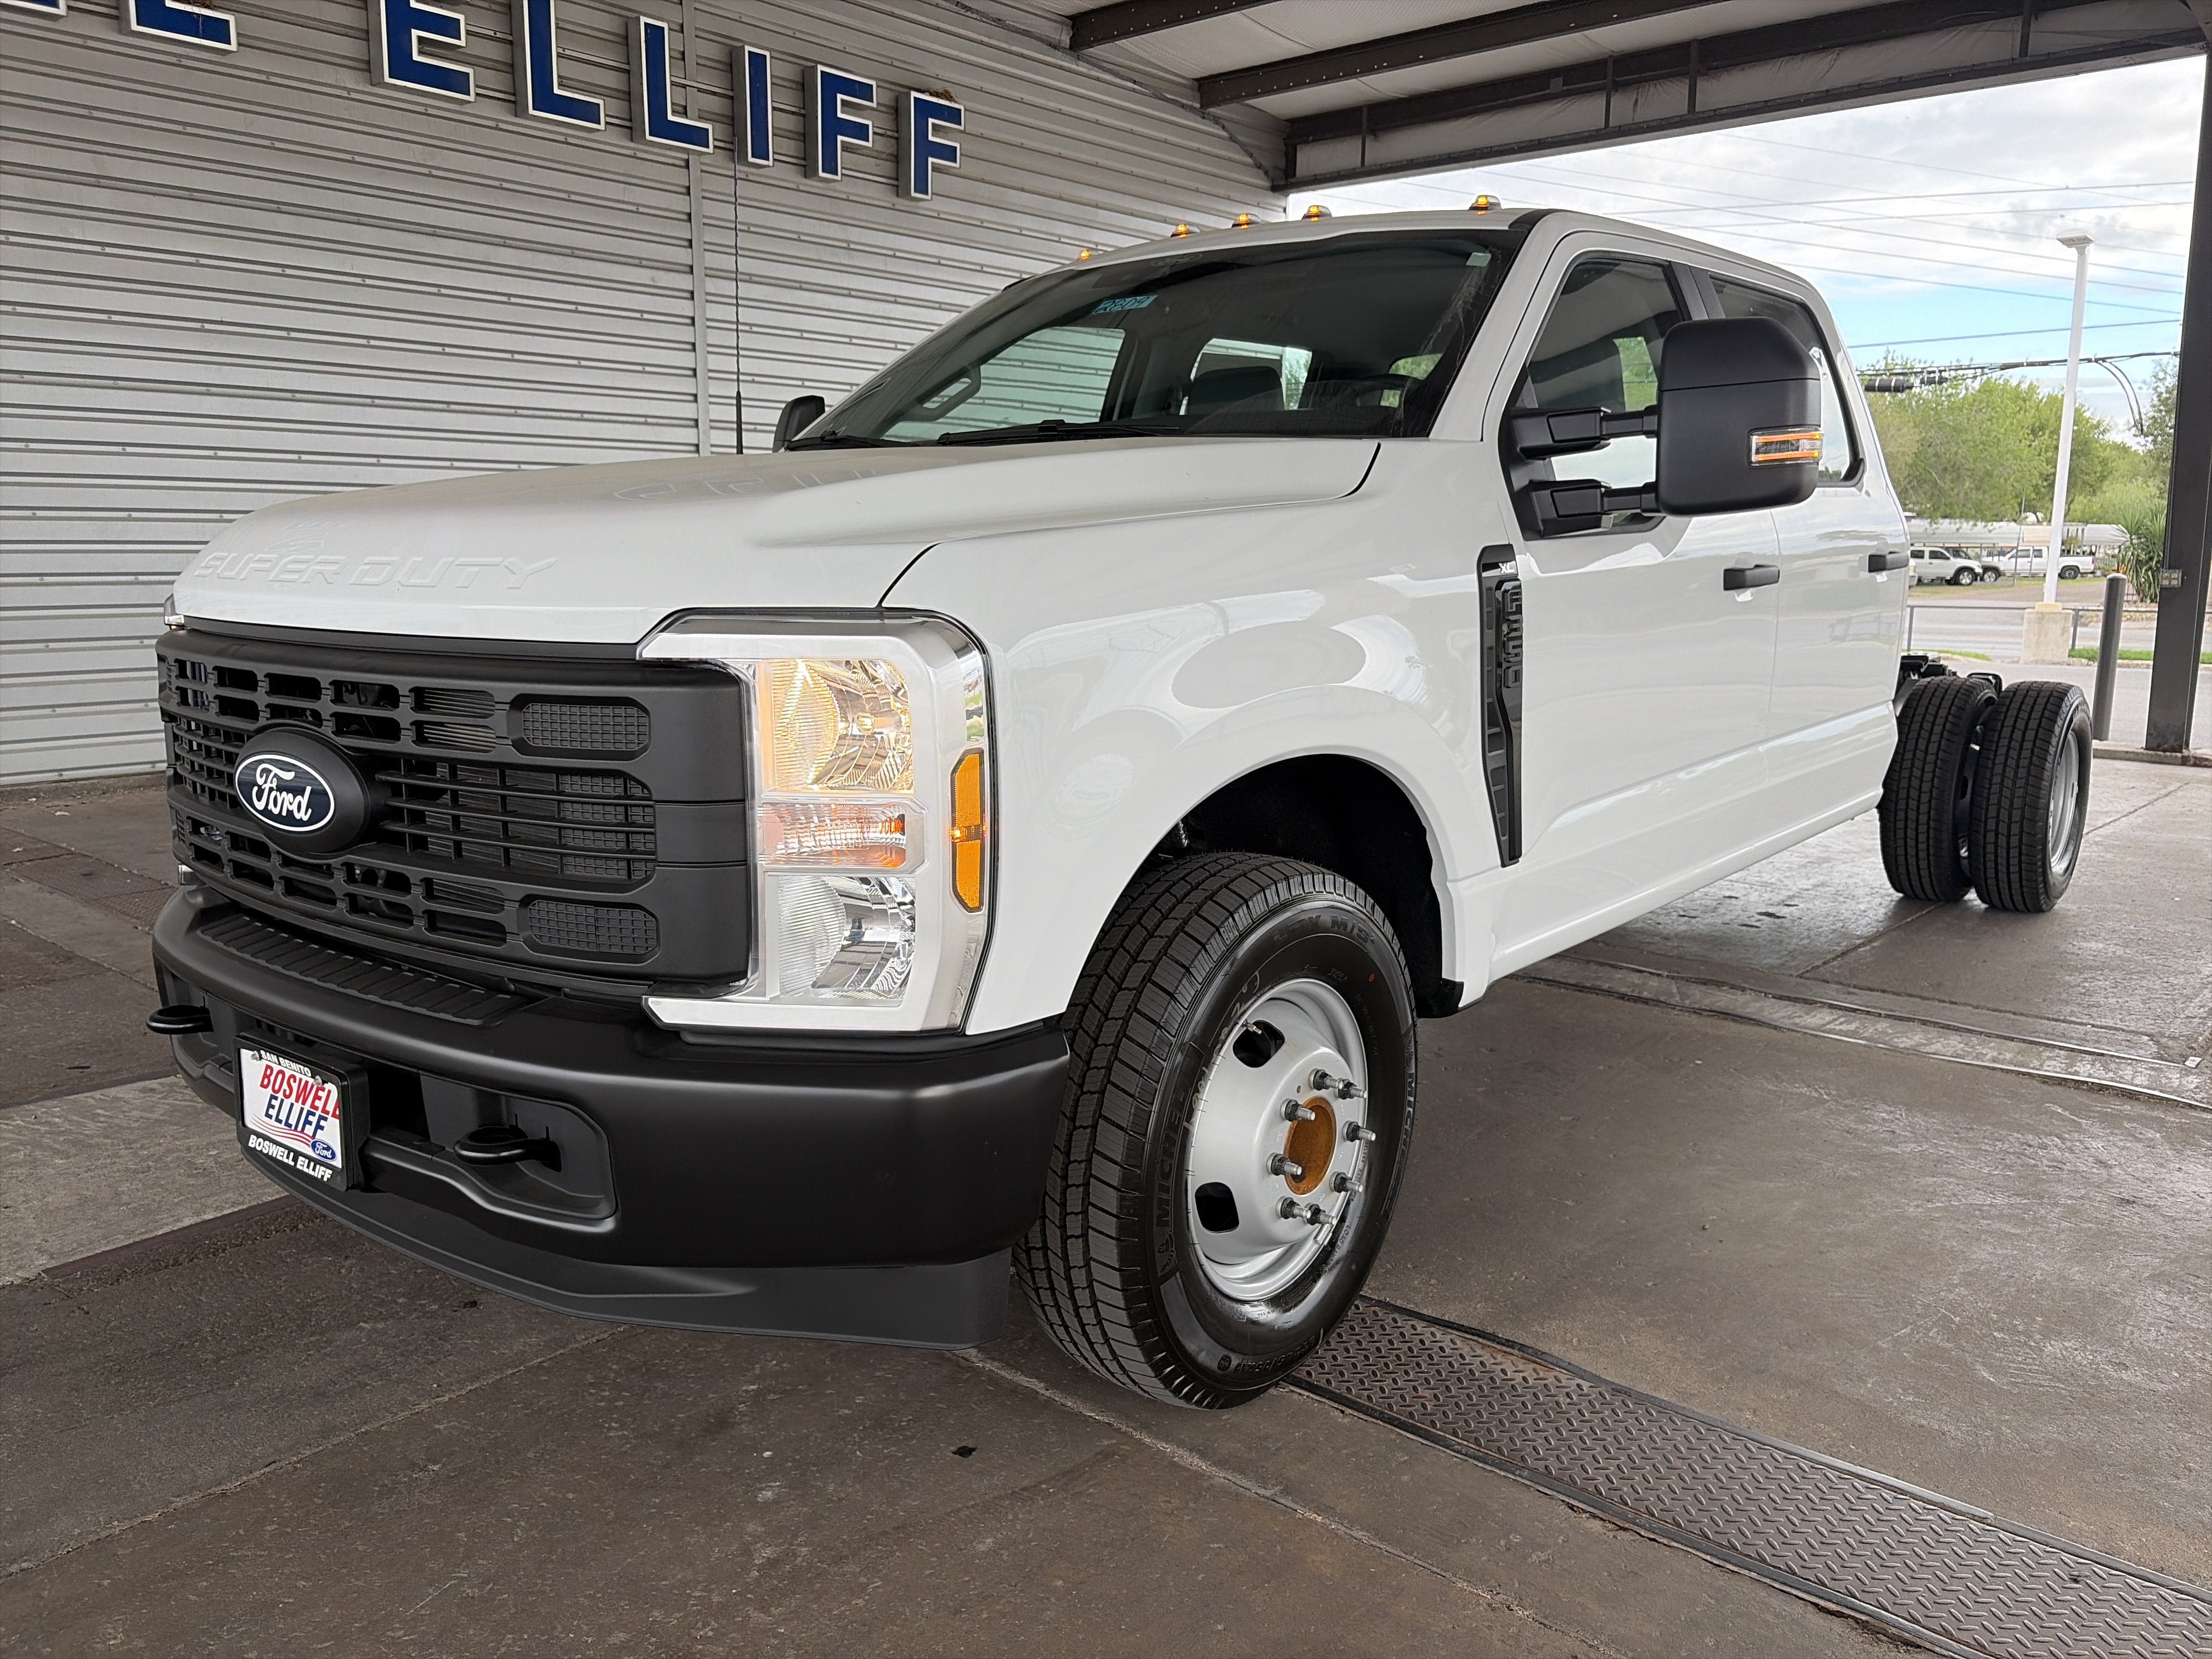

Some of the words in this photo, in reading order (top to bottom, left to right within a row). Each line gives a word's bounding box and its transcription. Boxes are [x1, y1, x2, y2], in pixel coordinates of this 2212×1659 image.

[371, 0, 964, 200] ELLIFF
[194, 552, 346, 584] SUPER
[349, 556, 558, 590] DUTY
[1498, 562, 1515, 574] XL
[252, 763, 312, 821] Ford
[260, 1049, 279, 1064] SAN
[279, 1057, 312, 1077] BENITO
[264, 1093, 328, 1139] ELLIFF
[248, 1135, 295, 1166] BOSWELL
[296, 1156, 332, 1182] ELLIFF
[314, 1142, 332, 1158] Ford
